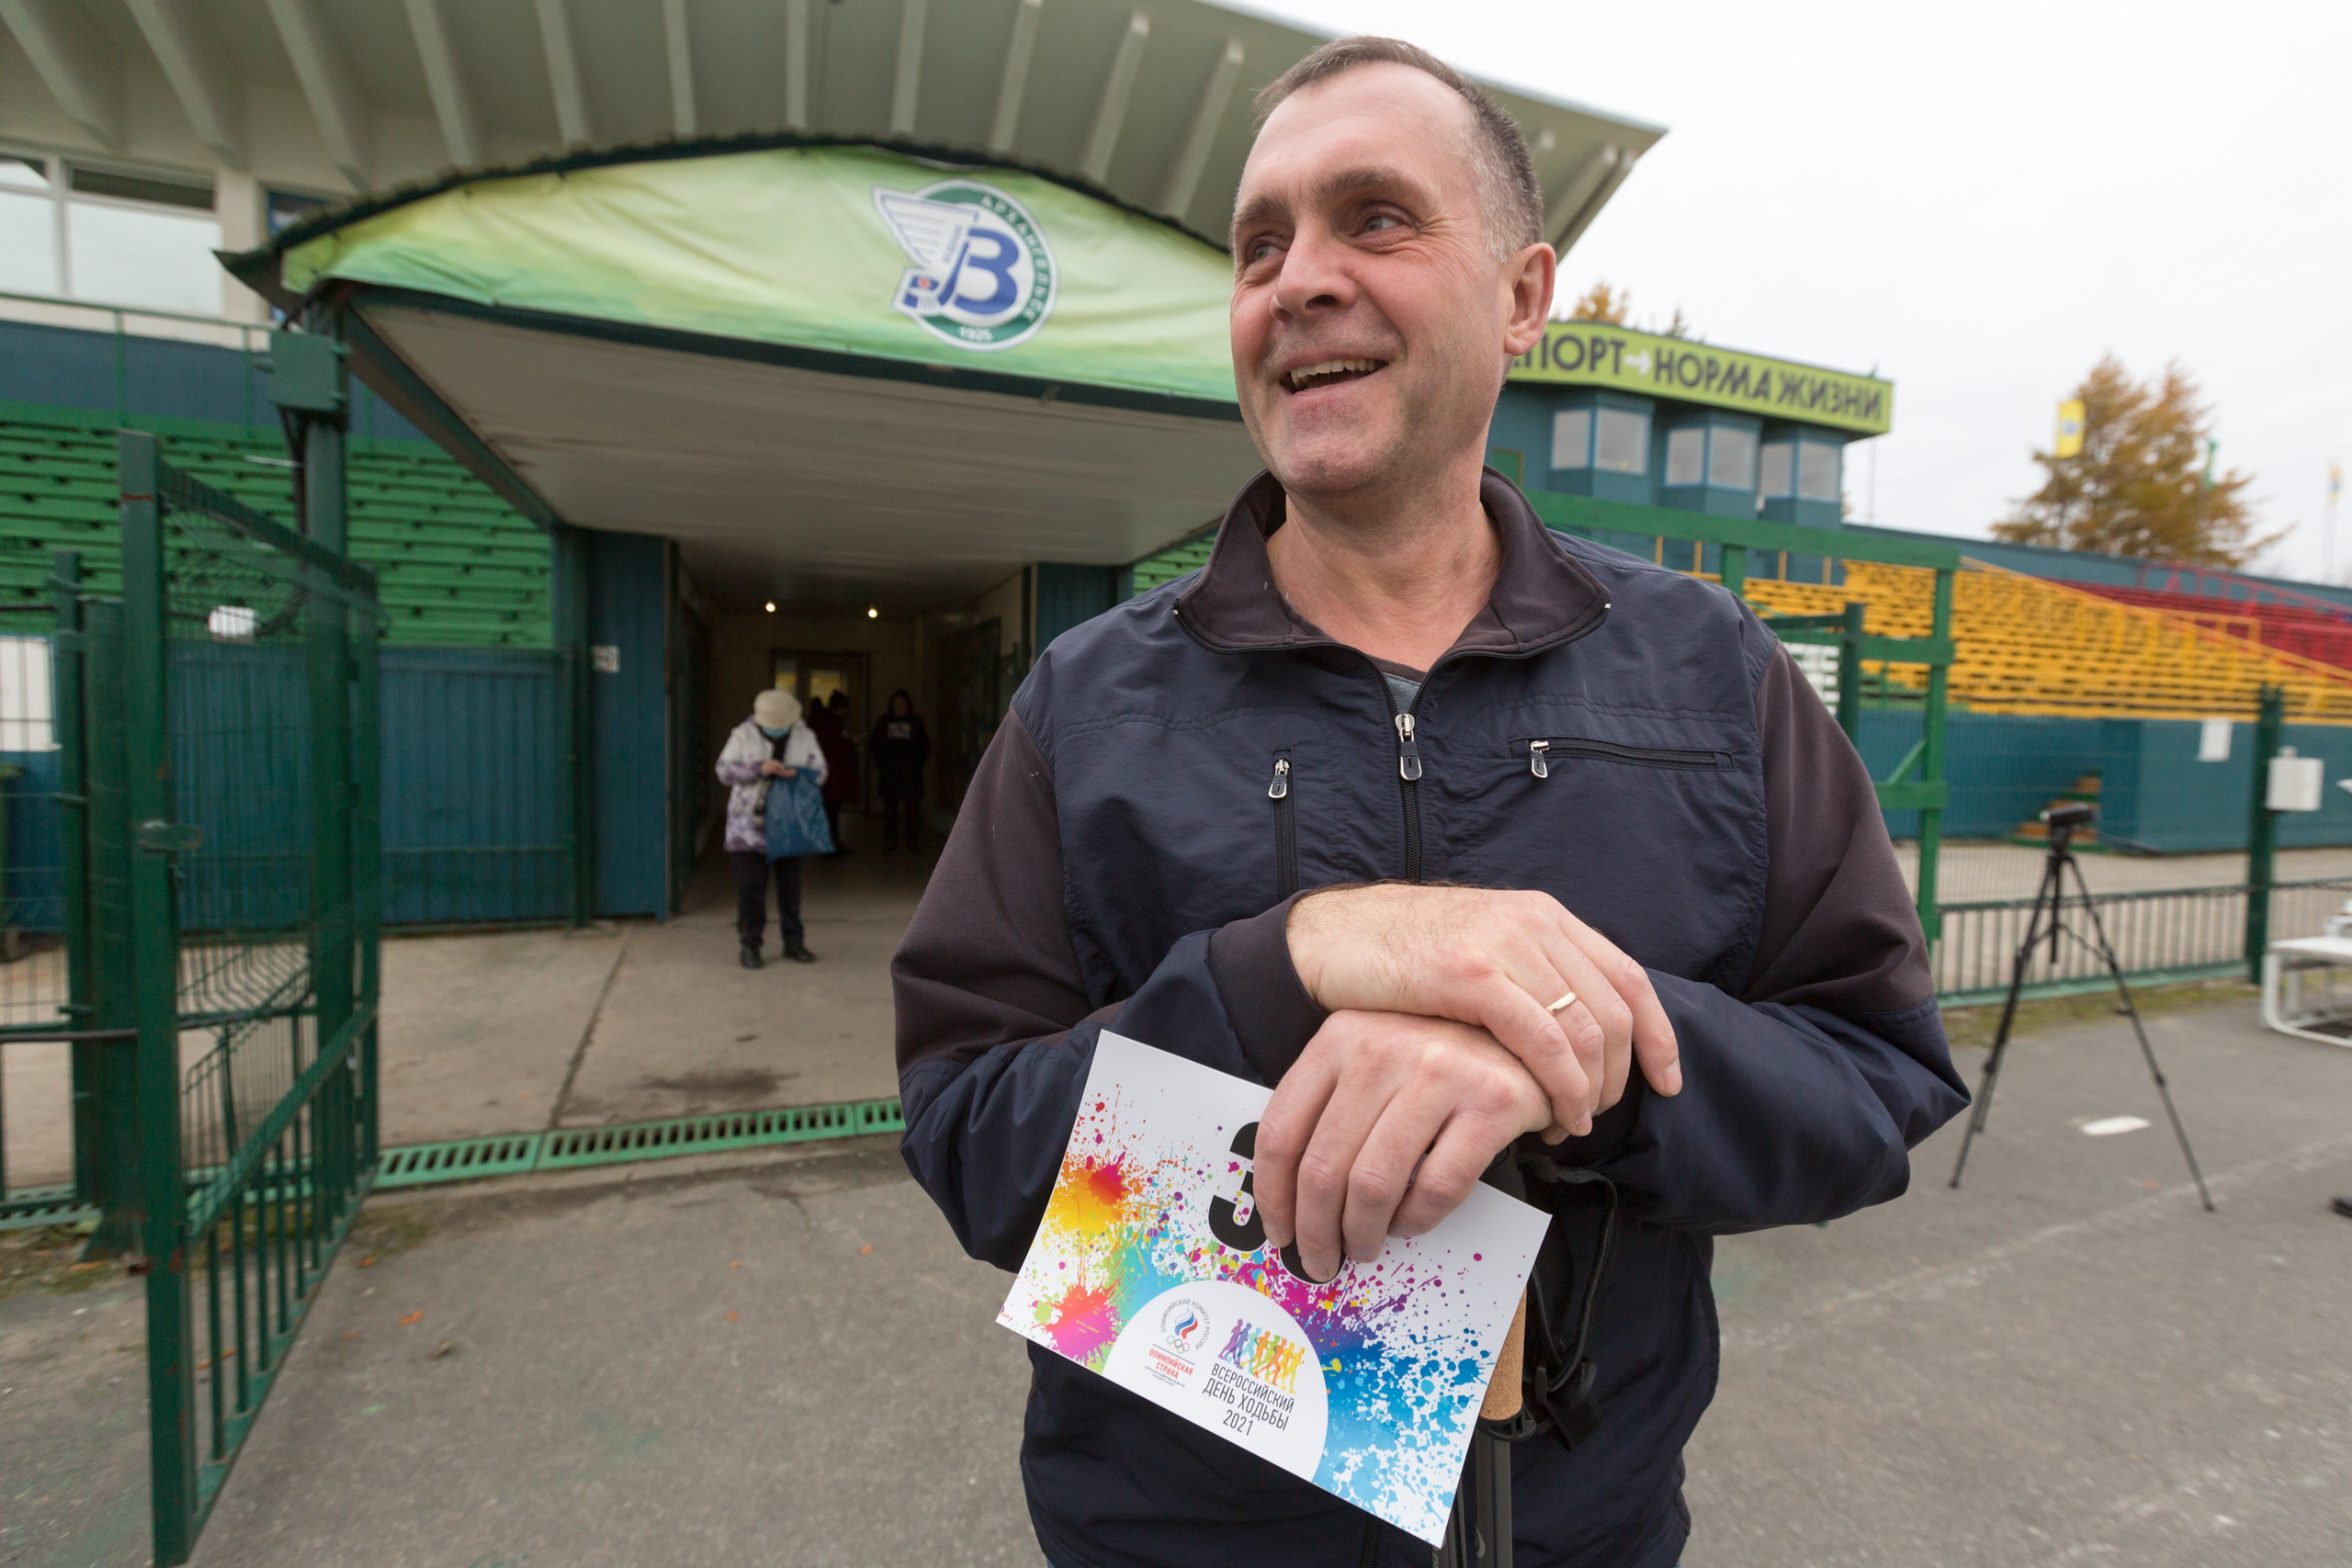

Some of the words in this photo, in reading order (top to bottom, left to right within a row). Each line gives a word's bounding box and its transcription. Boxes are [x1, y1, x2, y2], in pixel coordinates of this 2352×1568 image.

[980, 195, 1050, 321] АРХАНГЕЛЬСК
[958, 325, 994, 342] 1925
[1515, 332, 1626, 375] ПОРТ
[1654, 345, 1772, 402] НОРМА
[1776, 368, 1883, 422] ЖИЗНИ
[1160, 1298, 1191, 1334] ОЛИМПИЙСКИЙ
[1192, 1301, 1210, 1325] КОМИТЕТ
[1194, 1326, 1210, 1350] РОССИИ
[1148, 1348, 1193, 1376] ОЛИМПИЙСКАЯ
[1155, 1361, 1179, 1379] СТРАНА
[1211, 1363, 1295, 1414] ВСЕРОССИЙСКИЙ
[1202, 1377, 1236, 1404] ДЕНЬ
[1237, 1393, 1290, 1431] ХОДЬБЫ
[1222, 1409, 1253, 1437] 2021
